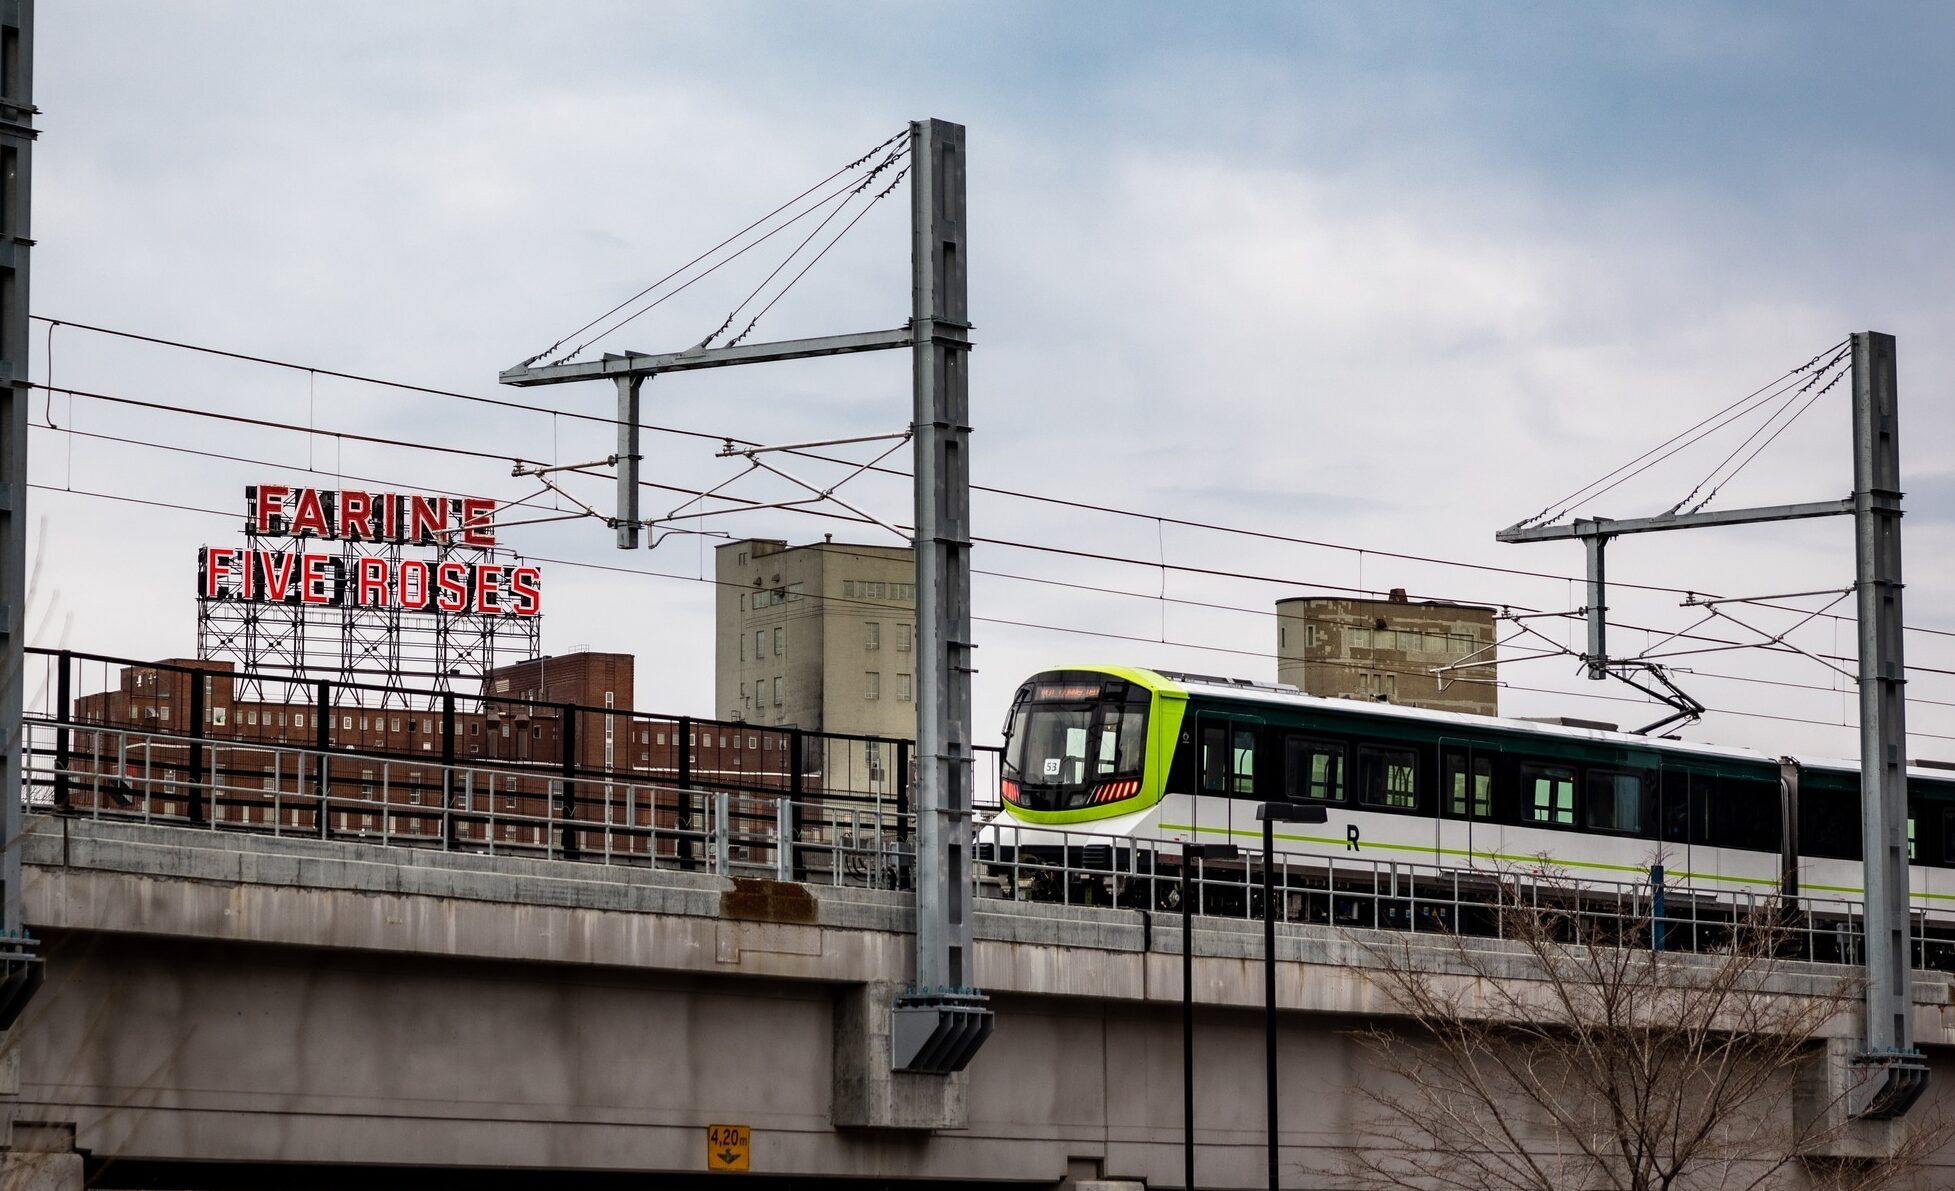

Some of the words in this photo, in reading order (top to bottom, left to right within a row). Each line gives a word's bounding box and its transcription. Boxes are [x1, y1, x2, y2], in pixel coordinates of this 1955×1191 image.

[255, 483, 497, 547] FARINE
[206, 547, 330, 605] FIVE
[358, 555, 542, 616] ROSES
[1046, 762, 1057, 771] 53
[1347, 824, 1360, 851] R
